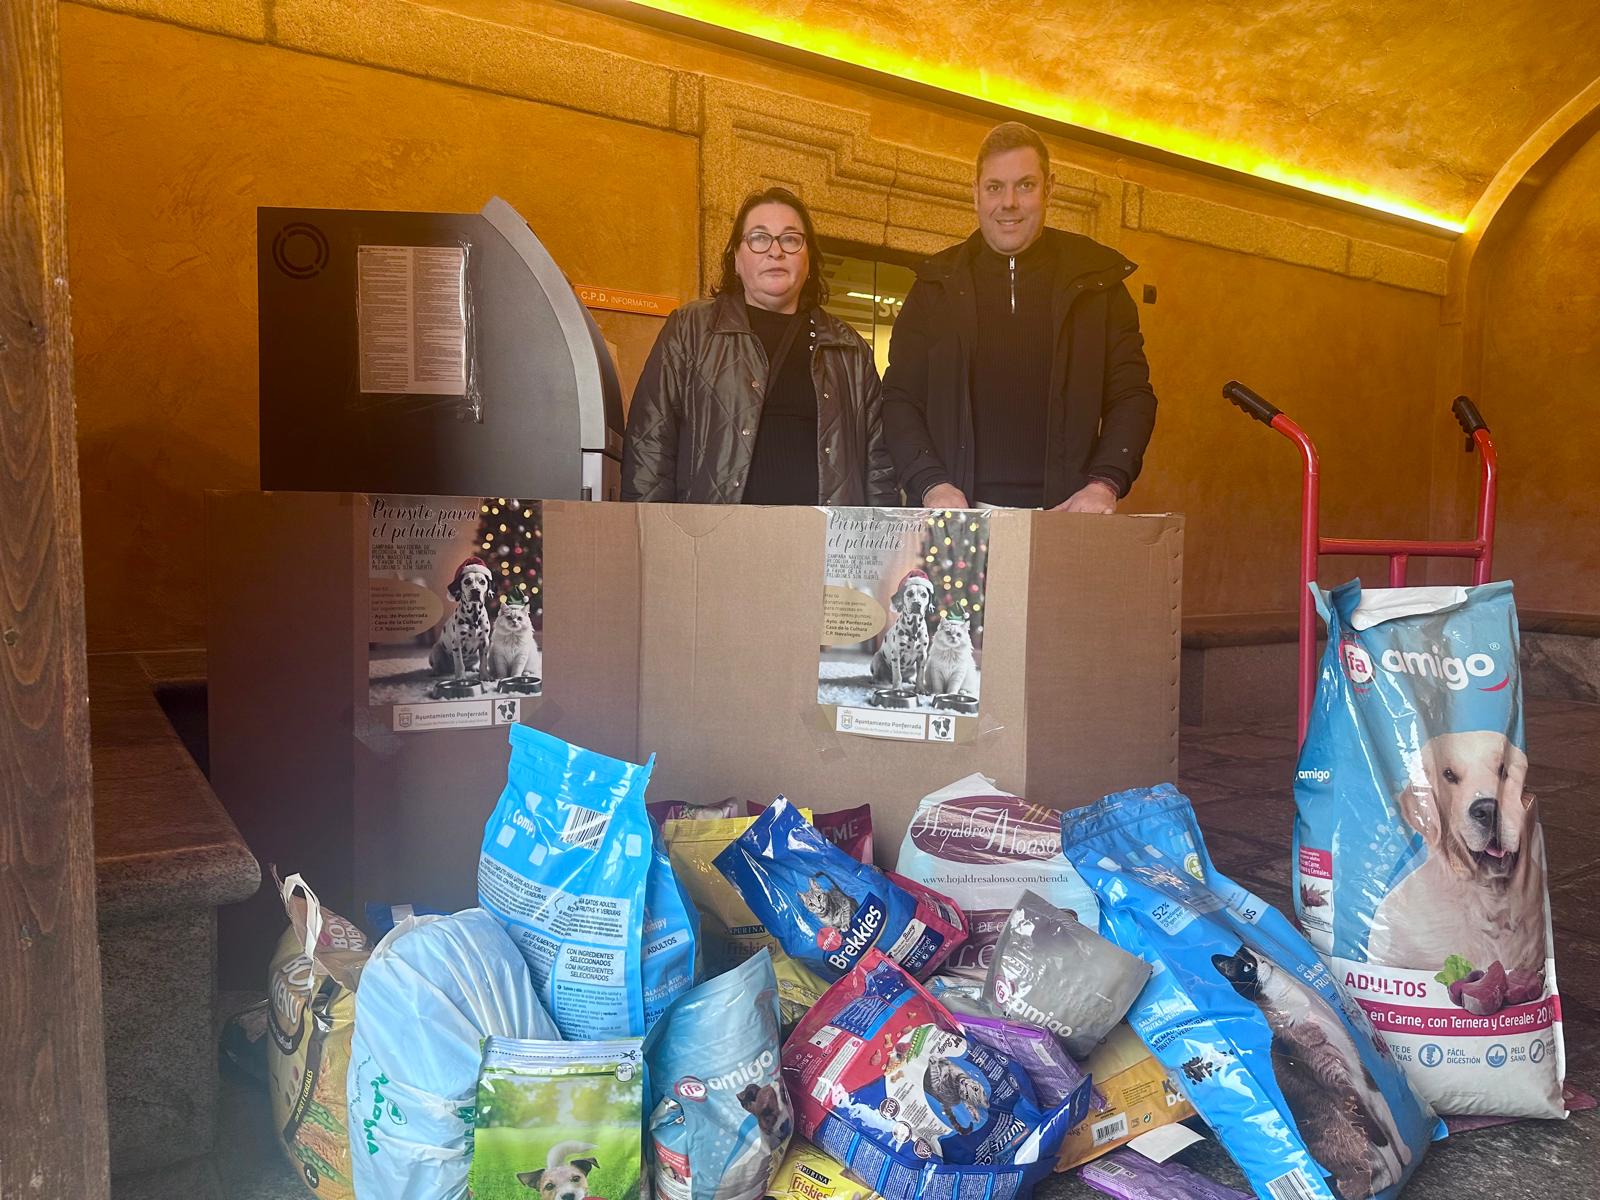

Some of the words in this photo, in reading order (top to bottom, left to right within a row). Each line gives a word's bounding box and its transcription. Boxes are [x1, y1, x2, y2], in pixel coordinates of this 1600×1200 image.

[581, 291, 609, 303] C.P.D.
[438, 508, 477, 525] para
[886, 522, 922, 537] para
[1347, 650, 1368, 675] fa
[1382, 645, 1495, 691] amigo
[1298, 767, 1330, 782] amigo
[911, 803, 992, 852] Hojaldres
[971, 807, 1057, 855] Alonso
[923, 873, 1068, 885] www.hojaldresalonso.com/tienda
[1152, 901, 1170, 920] 52%
[733, 926, 765, 934] PURINA
[828, 905, 882, 969] Brekkies
[578, 949, 614, 960] INGREDIENTES
[647, 937, 678, 955] ADULTOS
[569, 955, 612, 967] SELECCIONADOS
[577, 964, 614, 975] INGREDIENTES
[1345, 971, 1427, 998] ADULTOS
[1370, 1010, 1384, 1022] en
[1388, 1011, 1425, 1028] Carne,
[1428, 1018, 1447, 1028] con
[1450, 1015, 1489, 1028] Ternera
[1491, 1018, 1497, 1031] y
[1499, 1012, 1535, 1027] Cereales
[1536, 1007, 1548, 1025] 20
[1401, 1045, 1411, 1053] DE
[1510, 1046, 1525, 1055] PELO
[682, 1083, 703, 1096] ifa
[708, 1050, 773, 1091] amigo
[303, 1069, 313, 1098] CEREALES
[363, 1073, 389, 1156] RCADONA
[802, 1166, 828, 1185] PURINA
